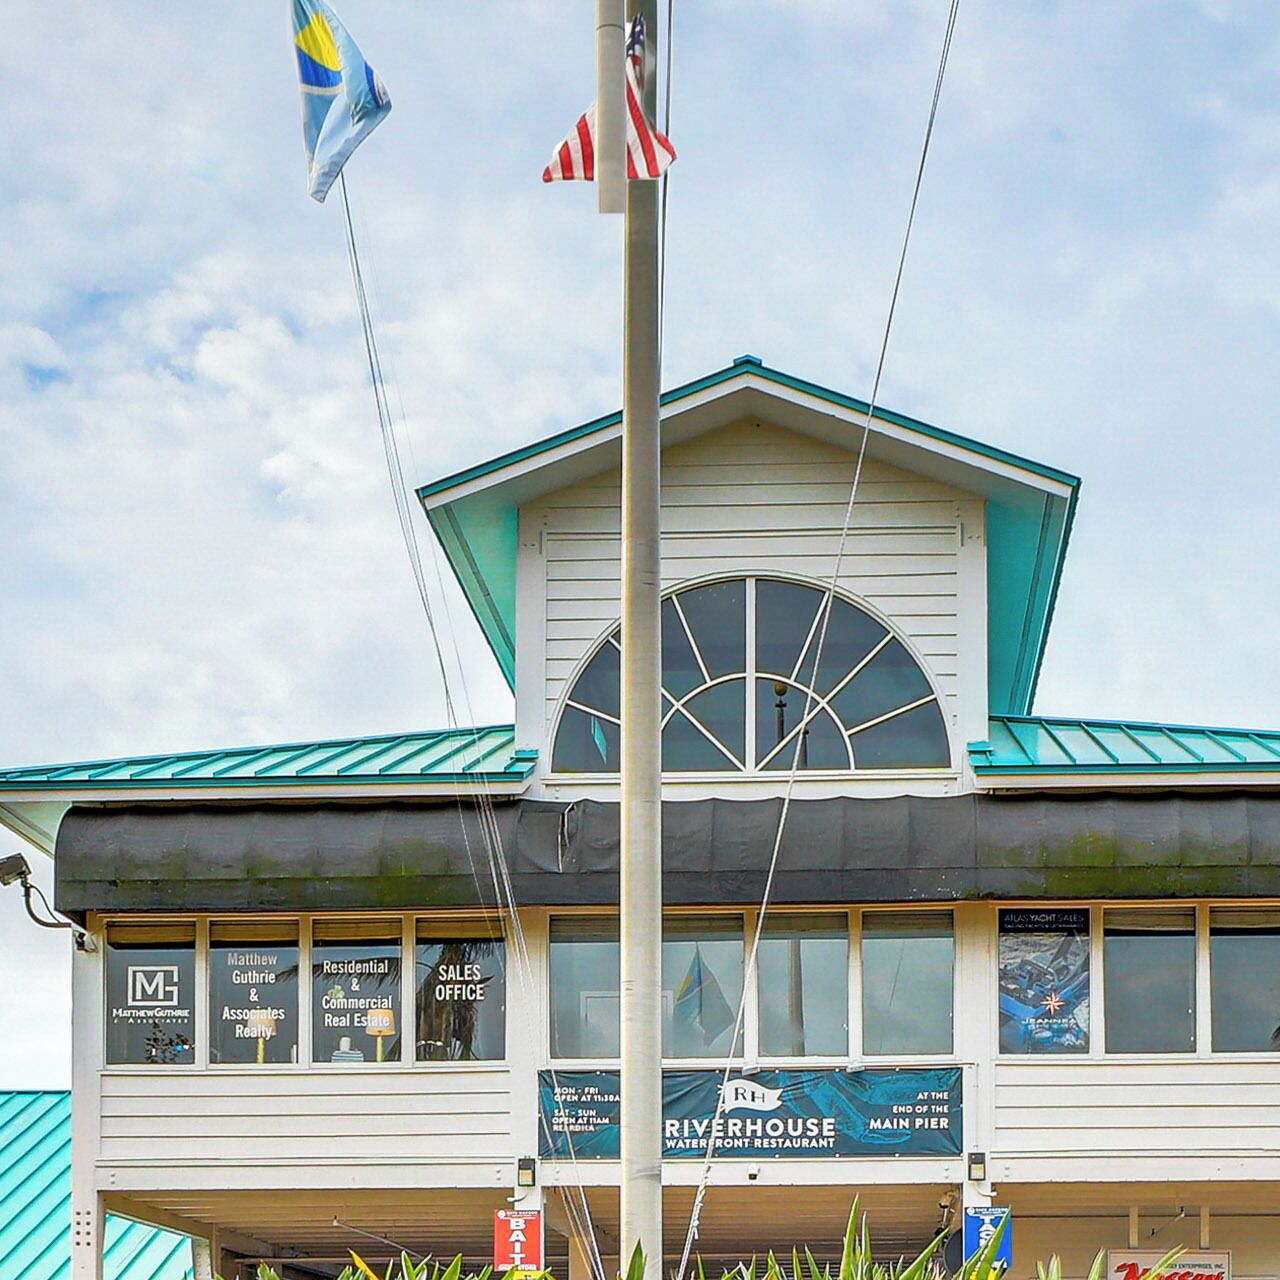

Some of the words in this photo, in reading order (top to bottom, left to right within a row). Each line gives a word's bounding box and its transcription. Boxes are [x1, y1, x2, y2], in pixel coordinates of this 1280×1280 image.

[1029, 914, 1056, 922] YACHT
[227, 952, 277, 966] Matthew
[323, 960, 388, 973] Residential
[438, 964, 481, 981] SALES
[232, 970, 276, 984] Guthrie
[351, 978, 360, 991] &
[249, 988, 258, 1001] &
[435, 984, 485, 1000] OFFICE
[322, 995, 392, 1009] Commercial
[222, 1006, 286, 1020] Associates
[324, 1013, 350, 1027] Real
[354, 1013, 390, 1027] Estate
[235, 1024, 272, 1040] Realty
[892, 1105, 913, 1113] END
[915, 1105, 928, 1113] OF
[931, 1105, 949, 1113] THE
[665, 1118, 836, 1137] RIVERHOUSE
[869, 1118, 910, 1129] MAIN
[914, 1118, 949, 1129] PIER
[754, 1138, 835, 1148] RESTAURANT
[508, 1219, 527, 1265] BAIT
